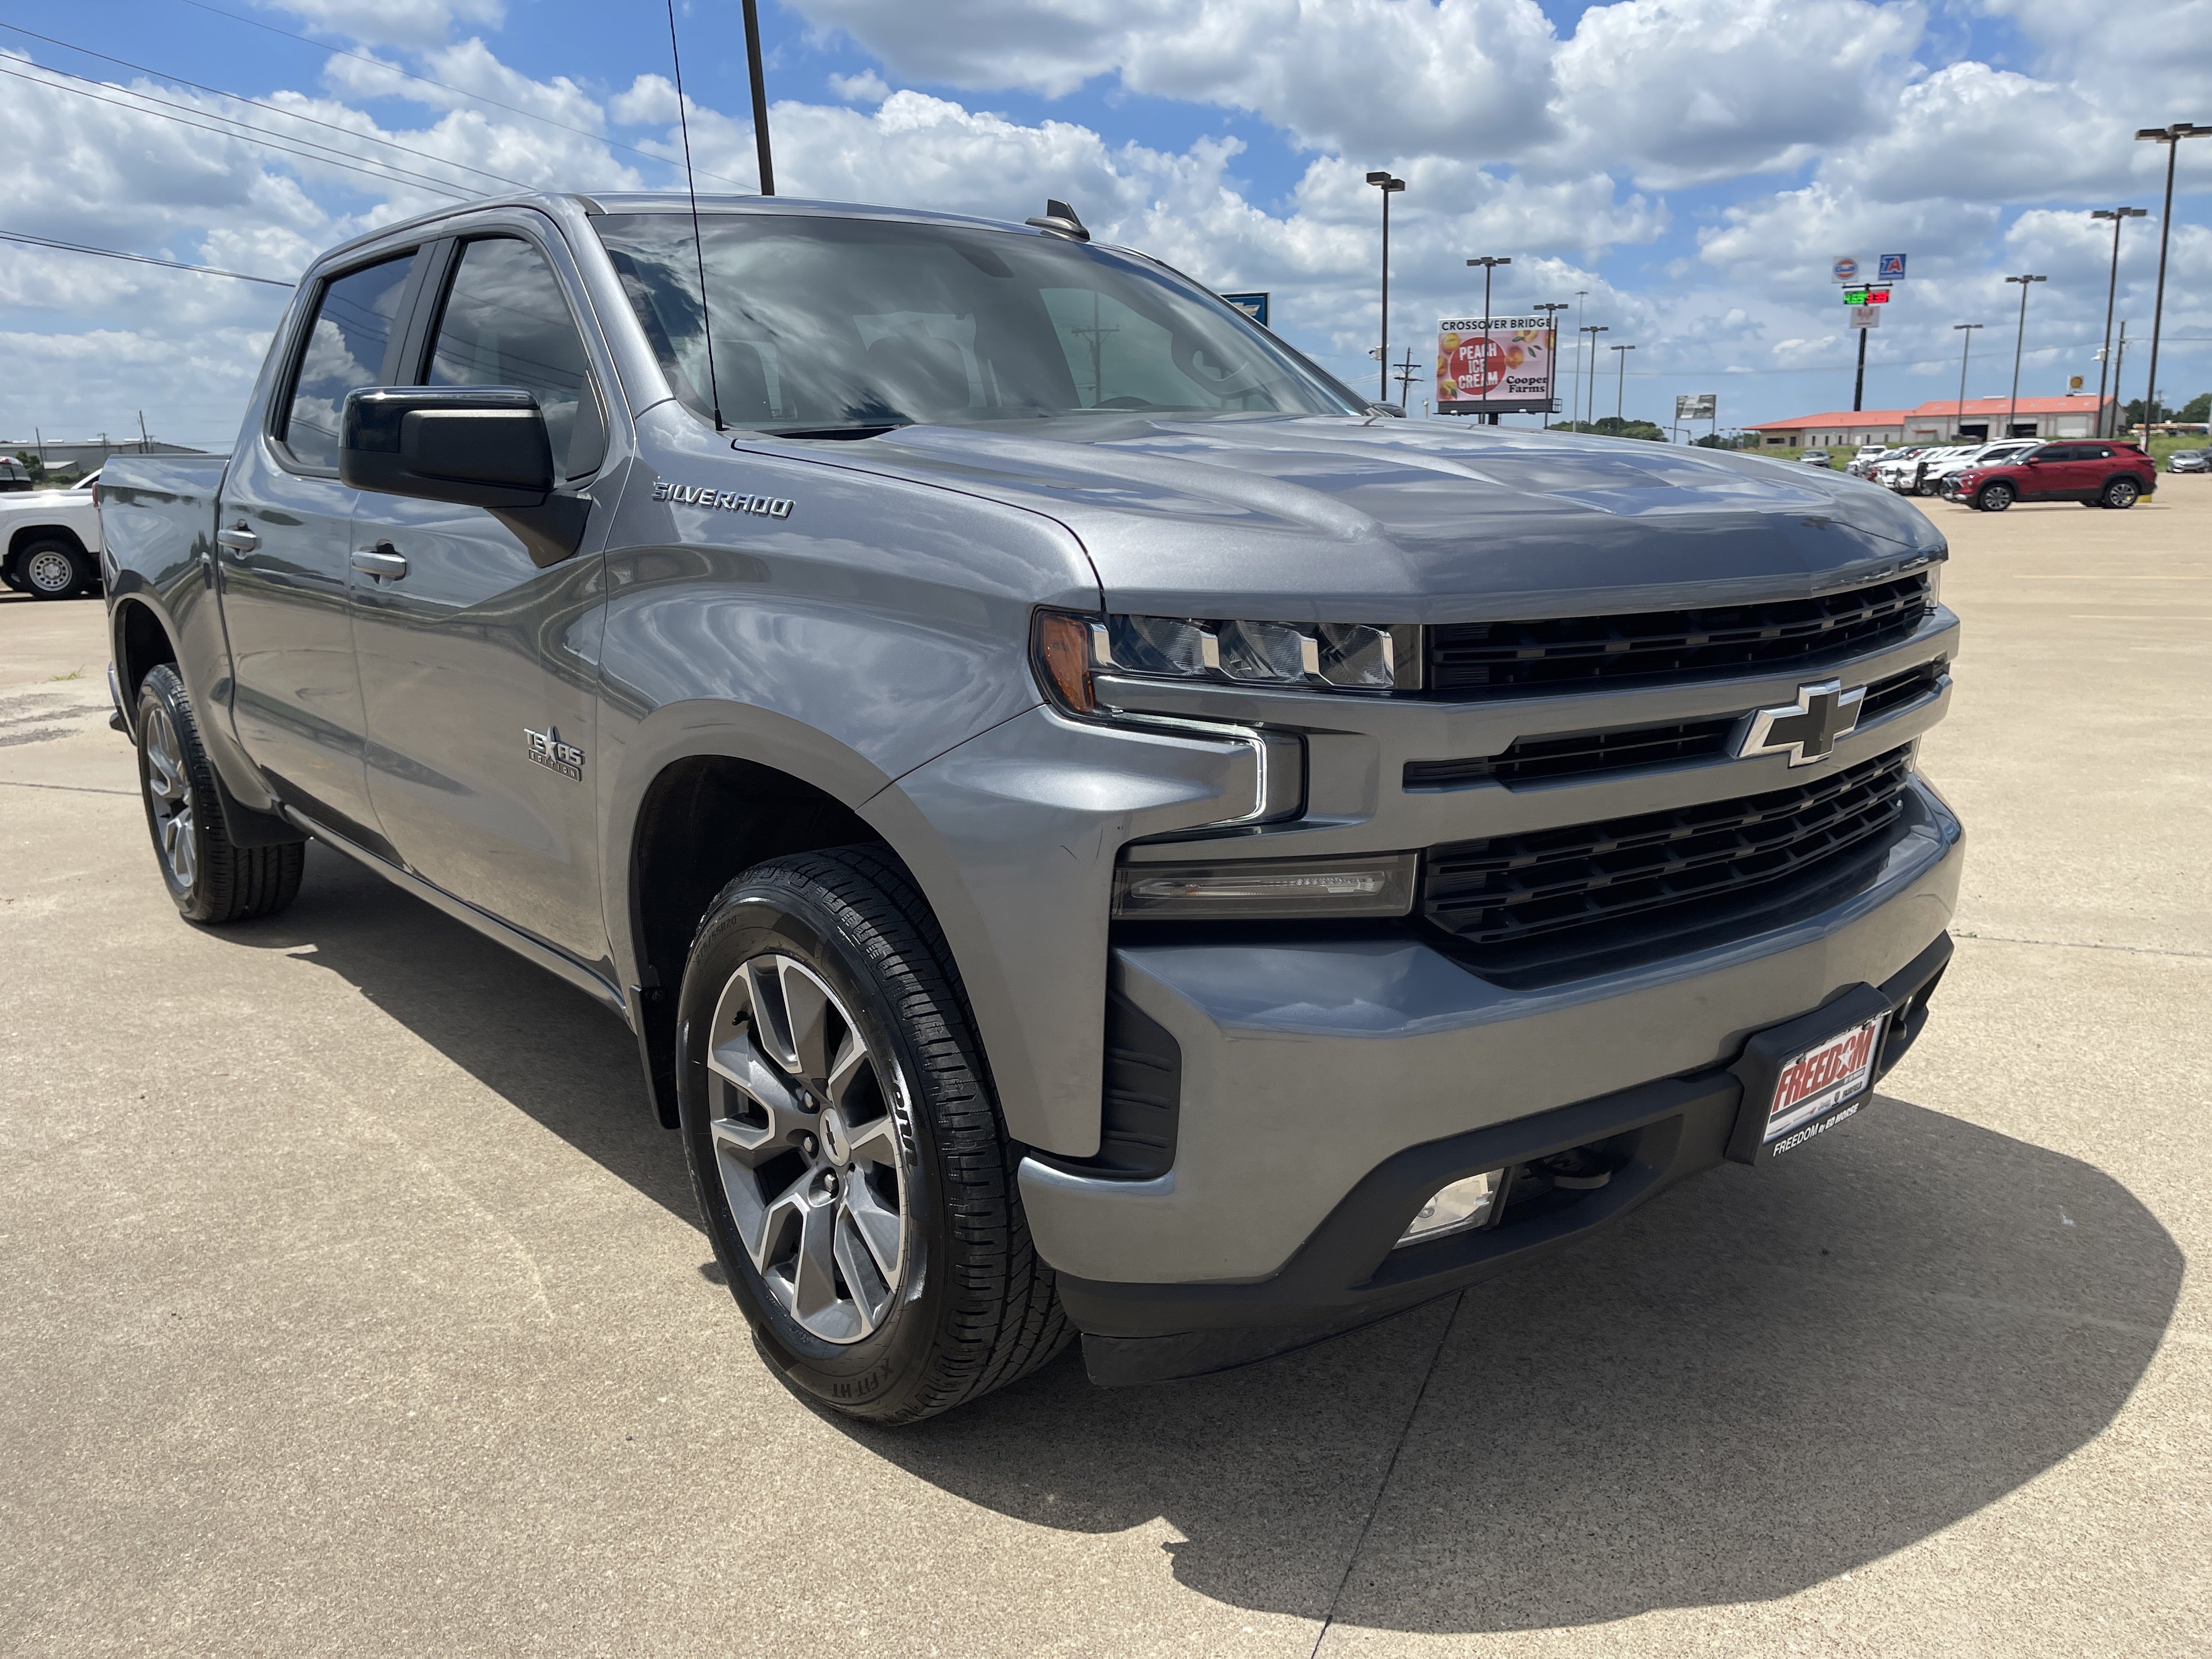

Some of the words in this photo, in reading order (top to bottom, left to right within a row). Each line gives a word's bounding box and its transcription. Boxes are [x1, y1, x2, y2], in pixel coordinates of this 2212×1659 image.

[1442, 320, 1507, 330] CROSSOVER
[1510, 318, 1551, 328] BRIDGE
[1459, 343, 1497, 360] PEACH
[1468, 359, 1485, 374] ICE
[1506, 376, 1548, 385] Cooper
[1509, 385, 1545, 393] Farms
[652, 482, 795, 518] SILVERADO
[531, 752, 575, 777] EDITION
[1772, 1025, 1876, 1113] FREEDOM
[1773, 1122, 1820, 1157] FREEDOM
[1825, 1116, 1836, 1130] ED
[1835, 1103, 1860, 1124] MORSE
